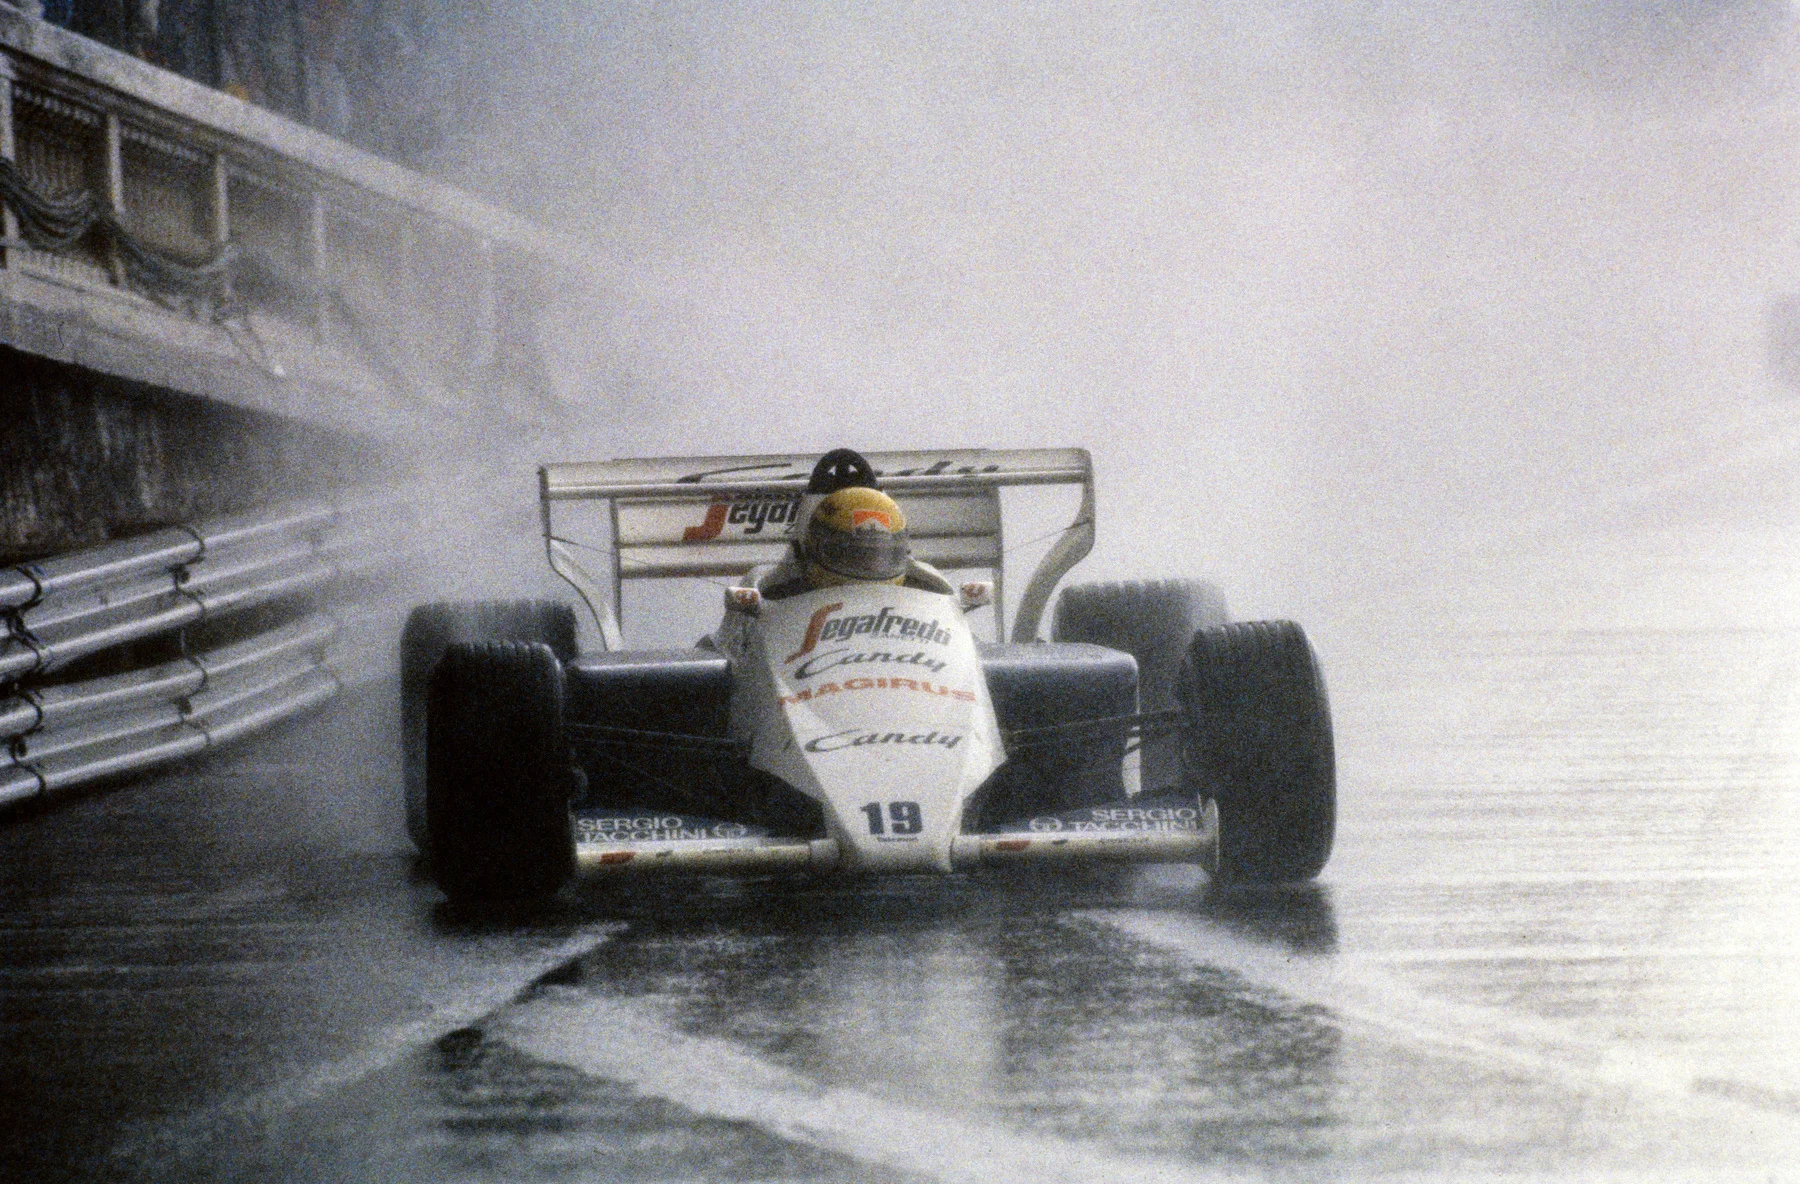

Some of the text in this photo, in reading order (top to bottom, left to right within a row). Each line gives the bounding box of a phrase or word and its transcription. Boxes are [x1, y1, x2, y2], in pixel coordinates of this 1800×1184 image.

[785, 602, 951, 664] Segafredo
[795, 649, 947, 680] Candy
[778, 677, 976, 705] MAGIRUS
[805, 729, 963, 753] Candy
[577, 816, 683, 832] SERGIO
[860, 801, 923, 835] 19
[1069, 821, 1198, 832] TACCHINI
[1091, 808, 1196, 821] SERGIO
[578, 828, 706, 842] TACCHINI
